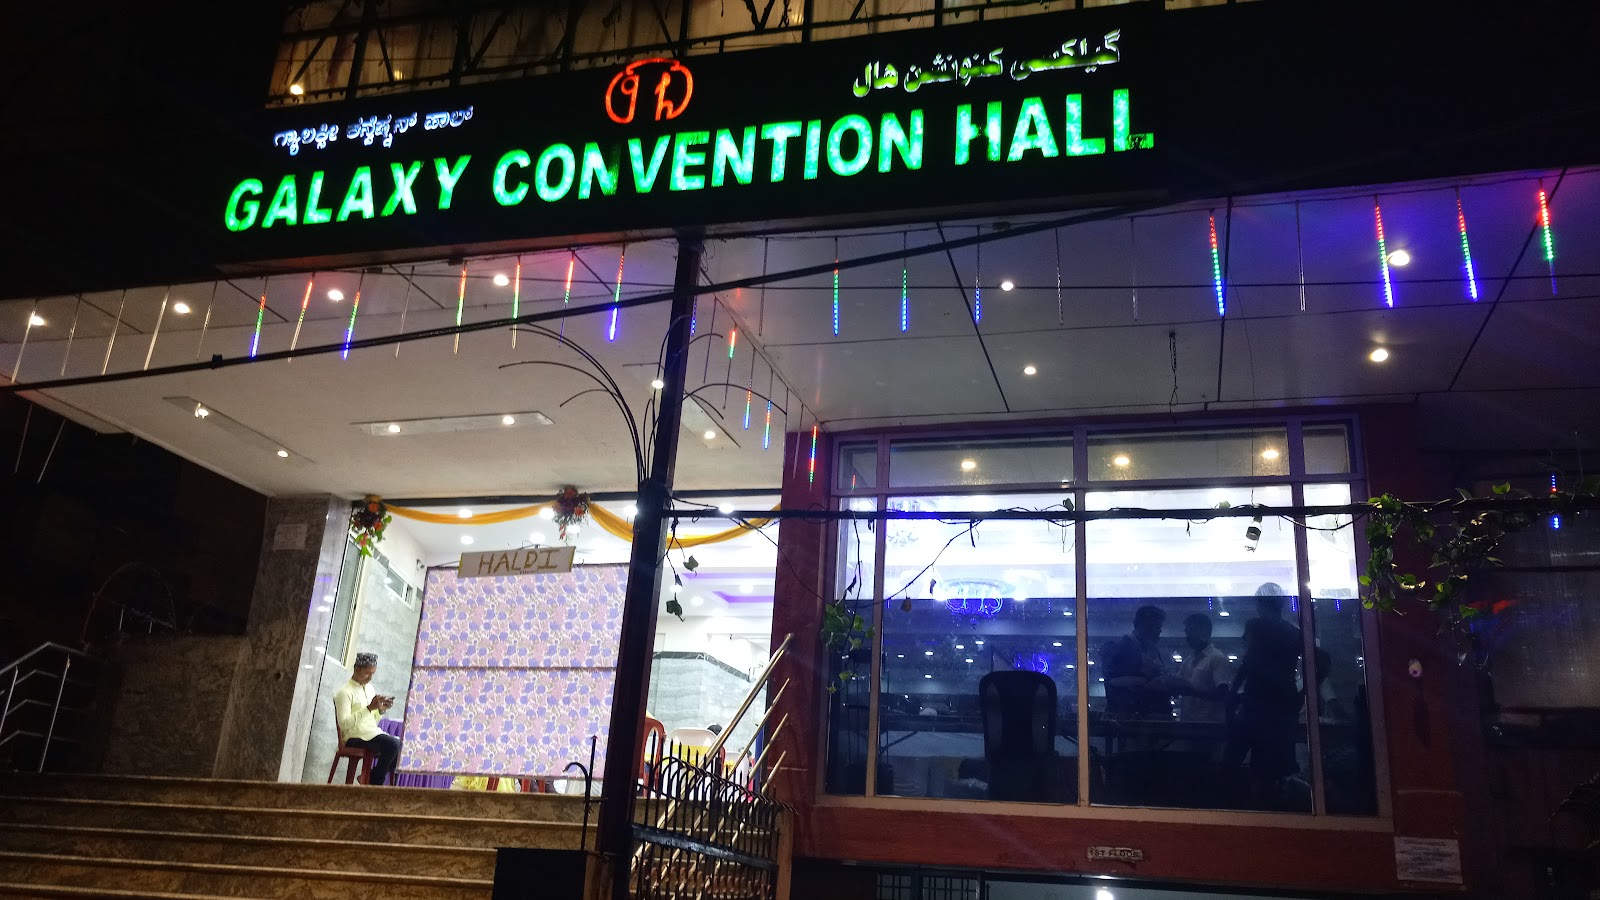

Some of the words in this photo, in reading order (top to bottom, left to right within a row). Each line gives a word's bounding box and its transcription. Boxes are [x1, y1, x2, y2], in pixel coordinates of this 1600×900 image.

[423, 105, 475, 131] ಹಾಲ್
[224, 153, 471, 233] GALAXY
[492, 109, 925, 207] CONVENTION
[953, 88, 1155, 166] HALL
[478, 550, 558, 574] HALDI
